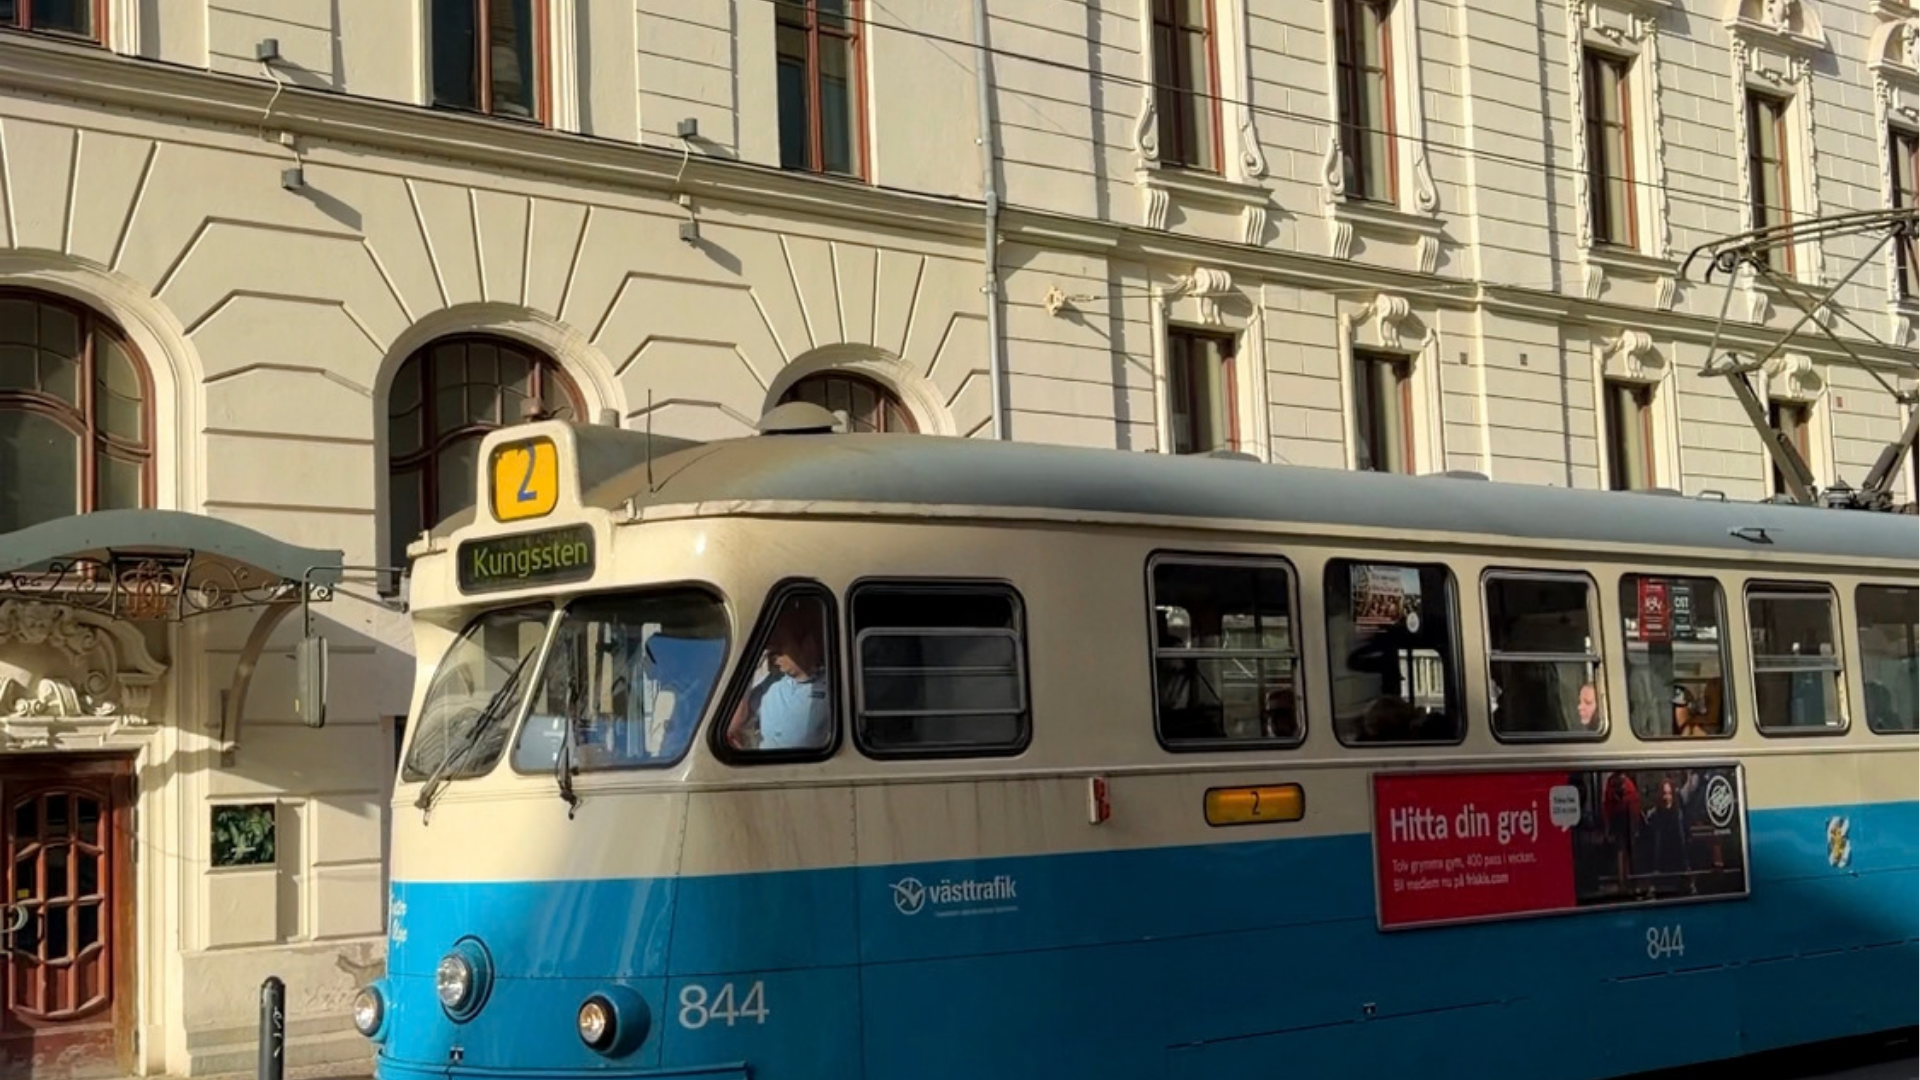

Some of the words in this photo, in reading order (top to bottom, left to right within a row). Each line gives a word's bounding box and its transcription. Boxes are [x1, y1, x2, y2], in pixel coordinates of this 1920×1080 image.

[516, 441, 538, 502] 2
[473, 541, 588, 577] Kungssten
[1250, 791, 1260, 816] 2
[1390, 806, 1448, 842] Hitta
[1455, 803, 1490, 838] din
[1498, 800, 1538, 845] grej
[1392, 859, 1408, 872] Tolv
[1411, 859, 1443, 875] grymma
[1467, 853, 1483, 867] 400
[1484, 854, 1502, 869] pass
[929, 875, 1017, 904] västtrafik
[1393, 877, 1404, 892] Bli
[1406, 876, 1440, 890] medlem
[1441, 878, 1453, 889] nu
[1454, 873, 1465, 889] på
[1466, 872, 1509, 886] friskis.com
[1646, 924, 1685, 959] 844
[679, 981, 770, 1029] 844
